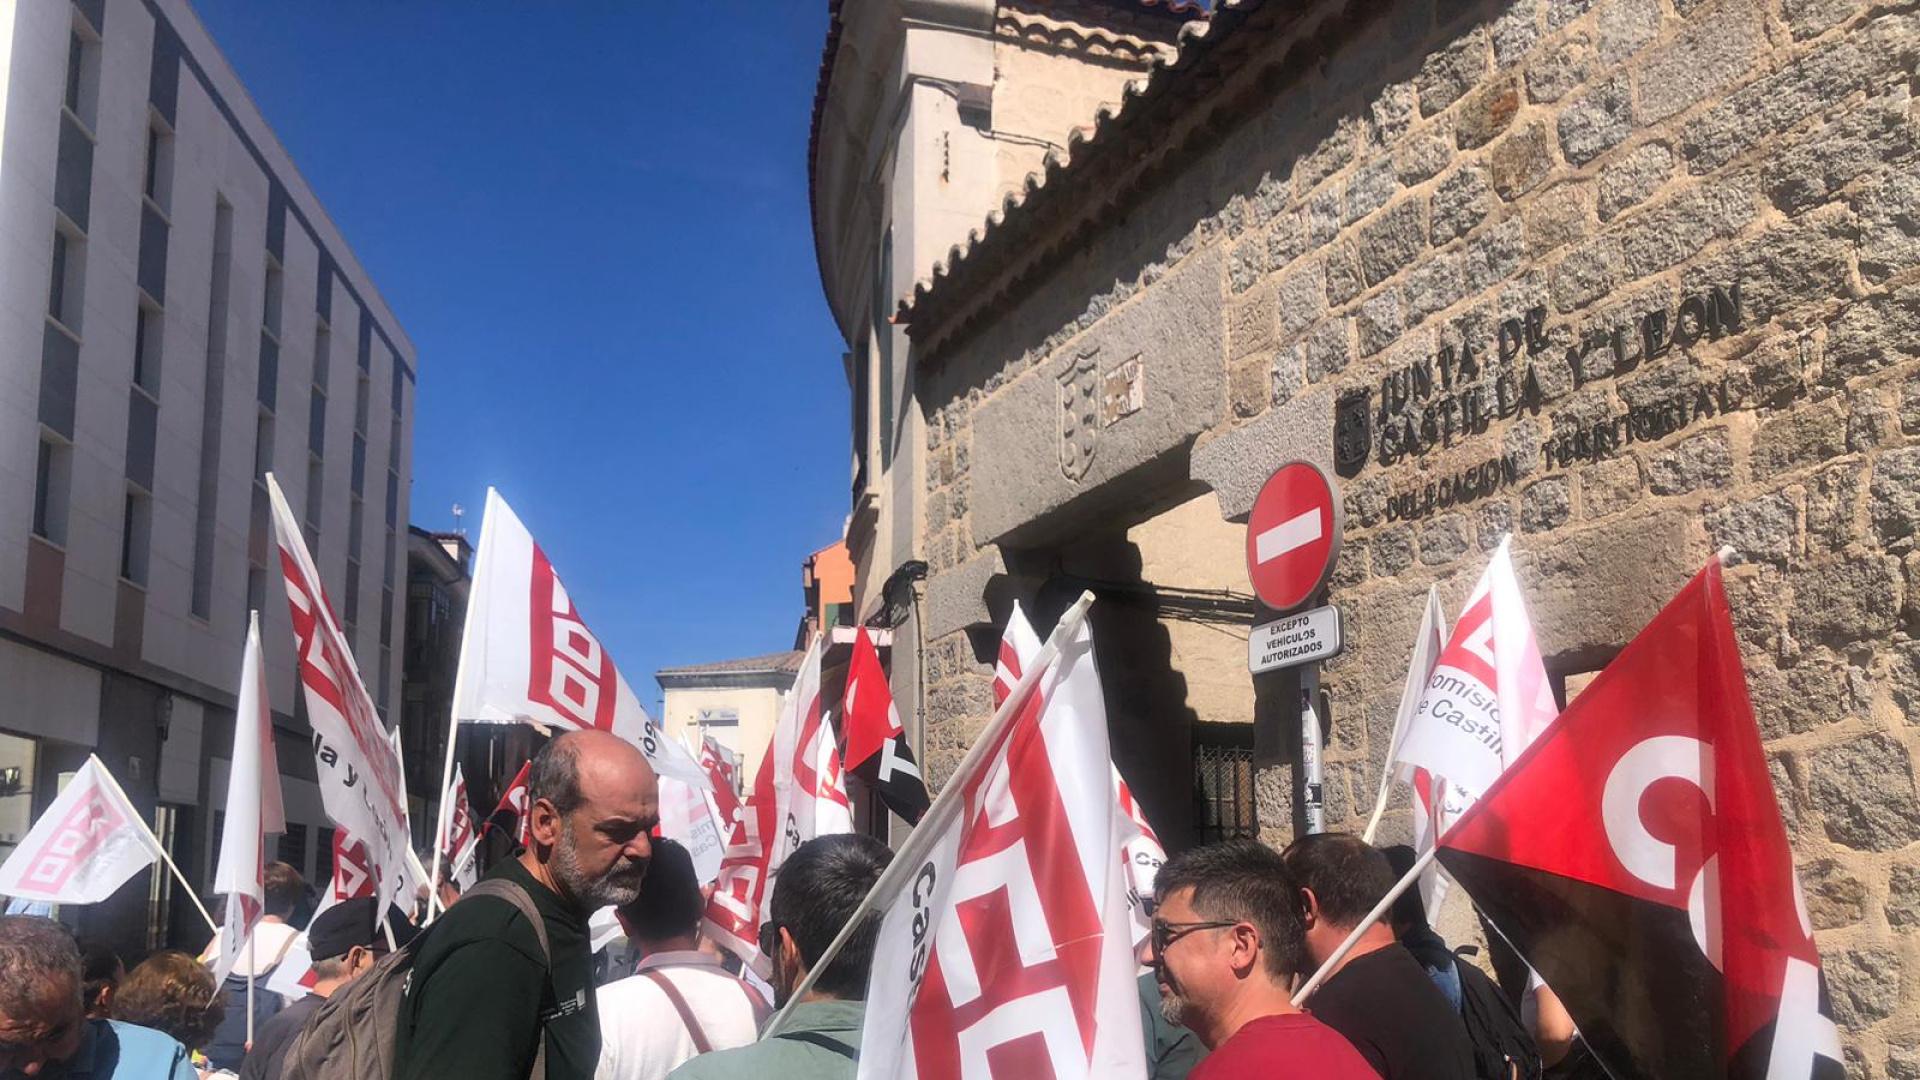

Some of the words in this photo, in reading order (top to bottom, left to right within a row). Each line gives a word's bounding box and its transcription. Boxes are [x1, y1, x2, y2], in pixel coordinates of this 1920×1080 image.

[1378, 337, 1479, 426] JUNTA
[1499, 306, 1550, 363] DE
[1378, 362, 1545, 468] CASTILLA
[1261, 640, 1324, 665] AUTORIZADOS
[1270, 616, 1310, 636] EXCEPTO
